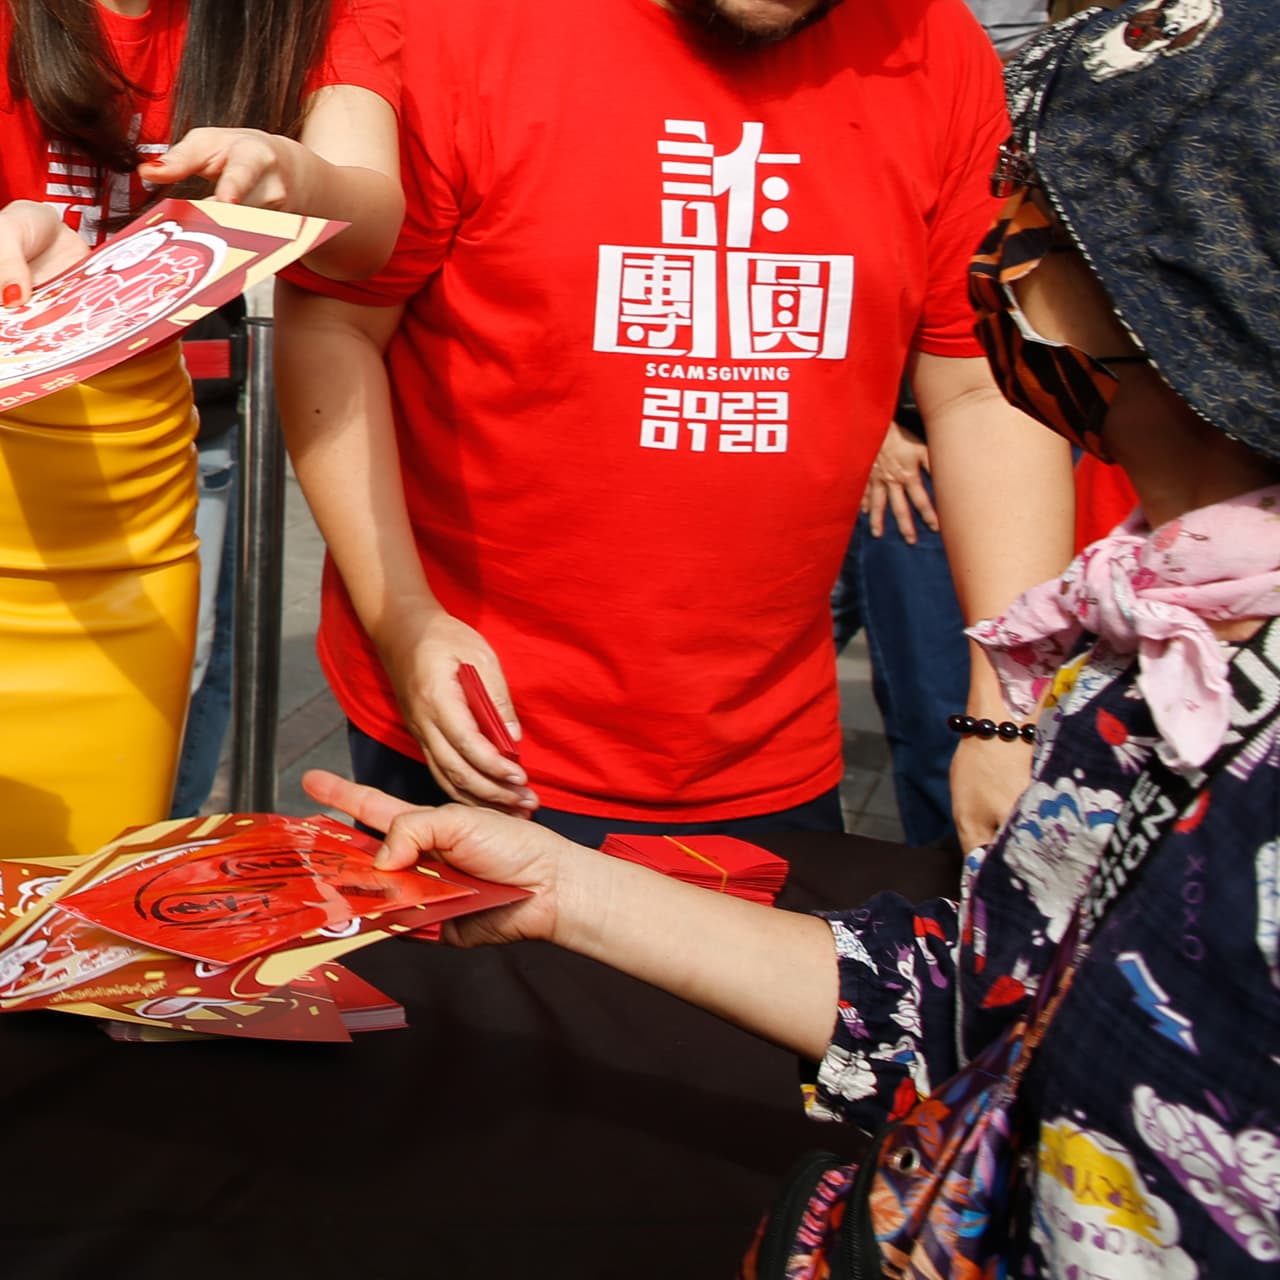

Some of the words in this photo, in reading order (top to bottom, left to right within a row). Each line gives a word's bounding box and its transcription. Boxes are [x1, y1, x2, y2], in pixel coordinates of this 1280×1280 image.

[592, 244, 855, 360] 團圓
[645, 362, 790, 382] SCAMSGIVING
[642, 387, 789, 421] 2023
[640, 419, 789, 453] 0120
